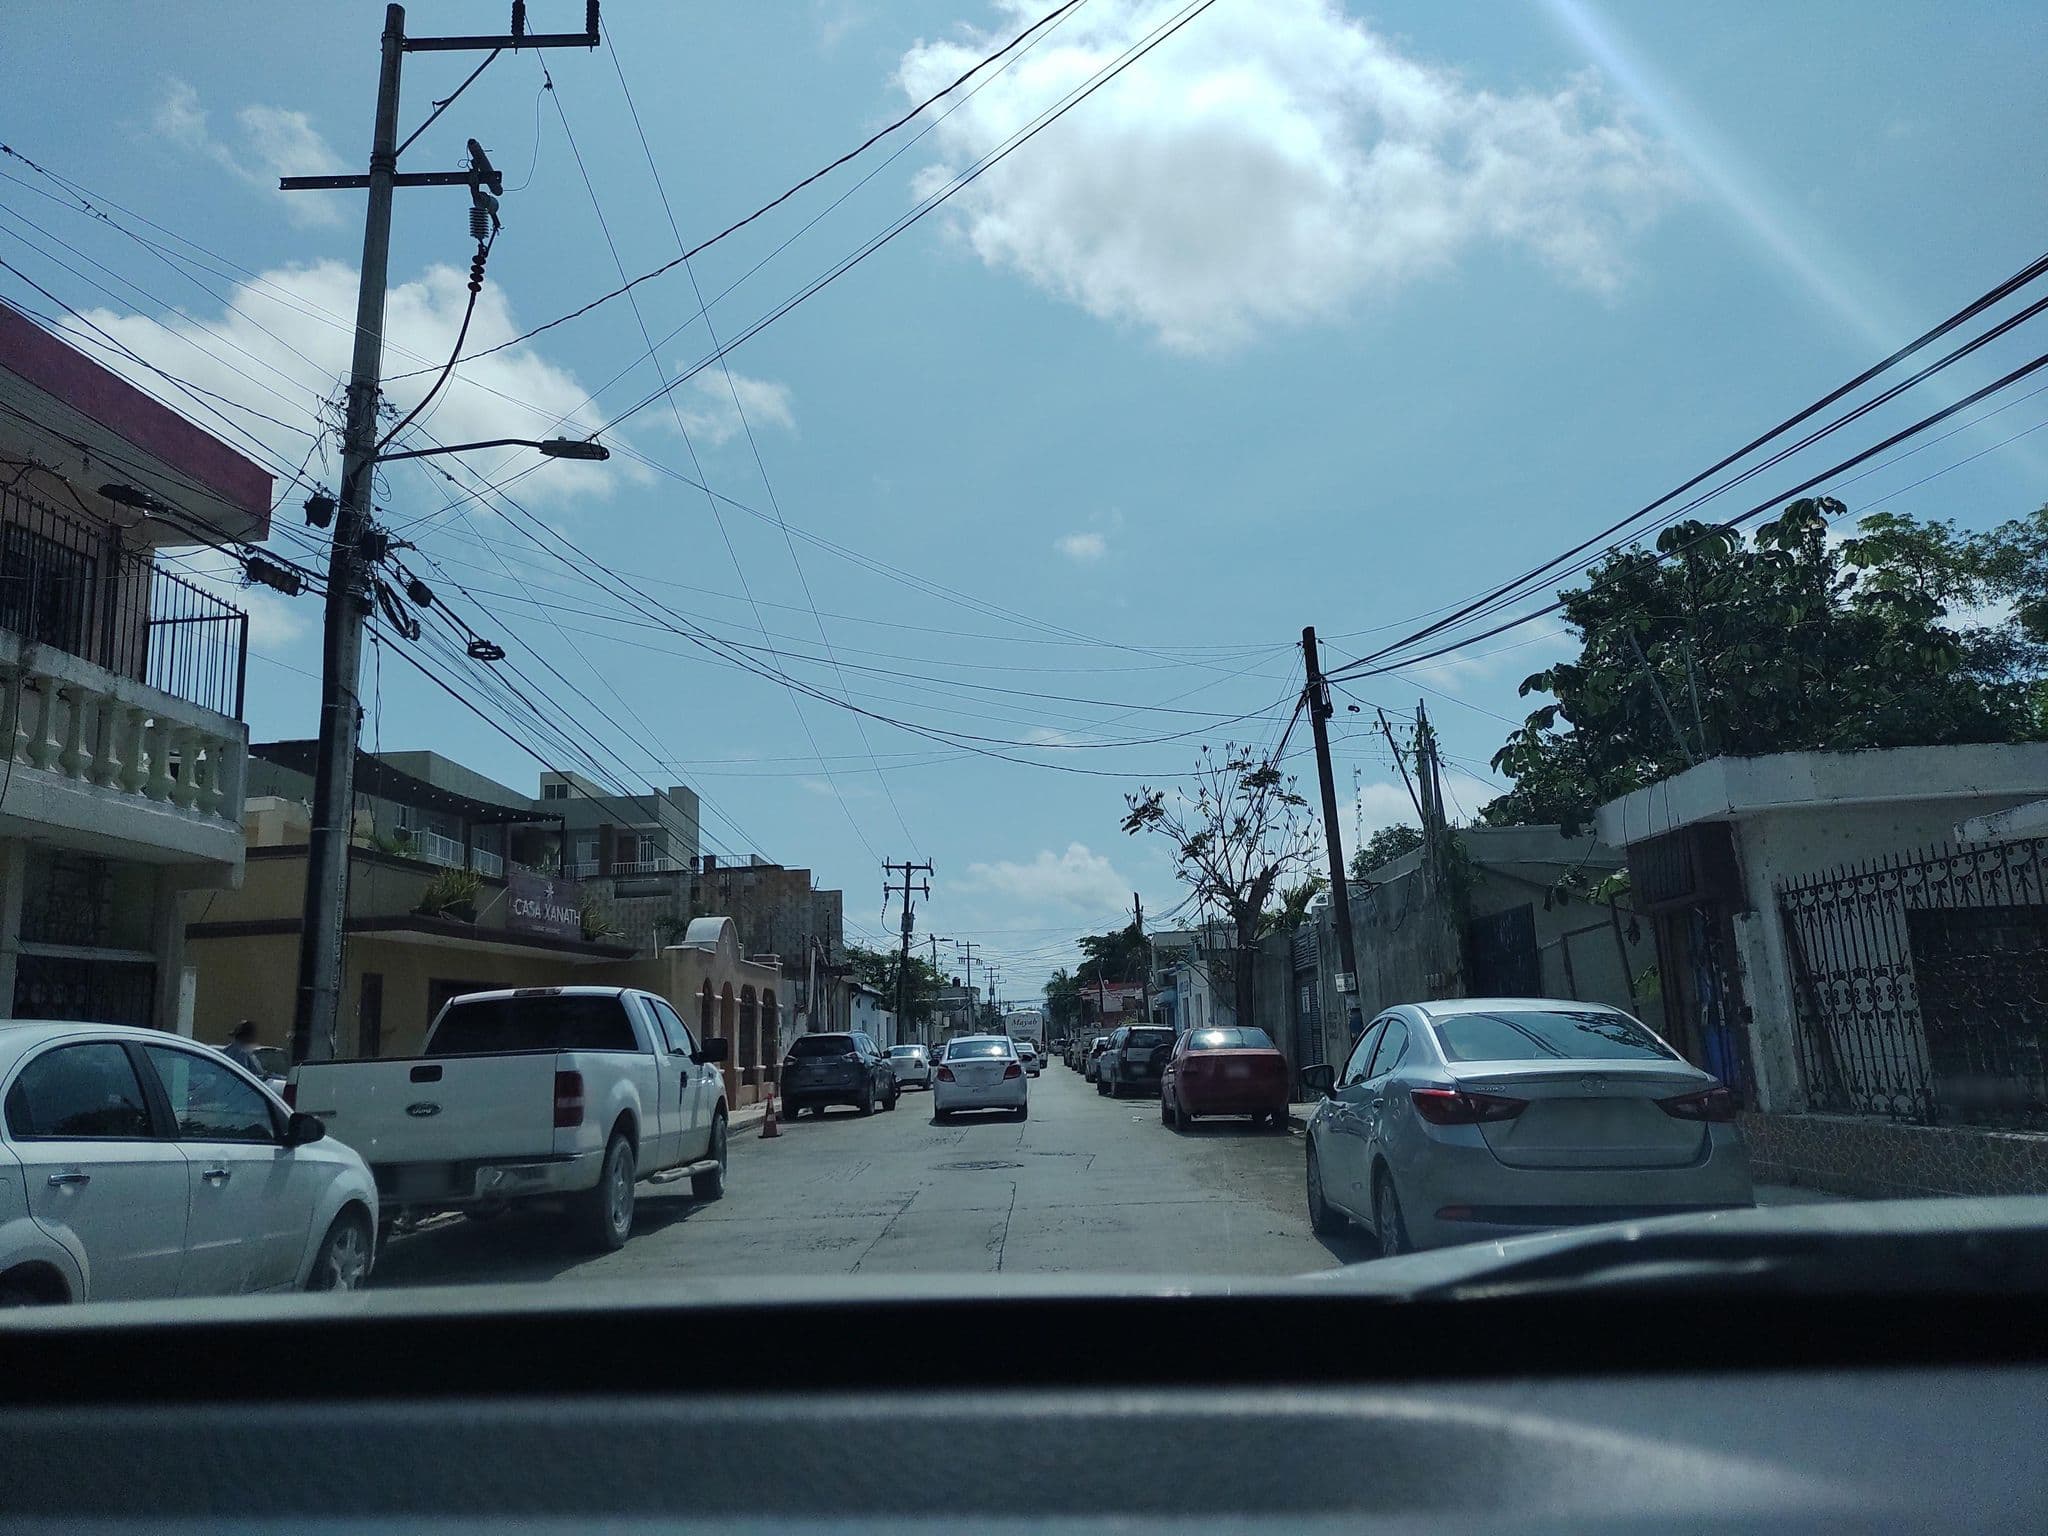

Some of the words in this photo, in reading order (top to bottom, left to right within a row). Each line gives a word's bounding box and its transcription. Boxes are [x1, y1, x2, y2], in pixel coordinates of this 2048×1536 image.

[514, 898, 541, 919] CASA
[544, 904, 581, 926] XANATH
[1013, 1017, 1038, 1028] Mayab
